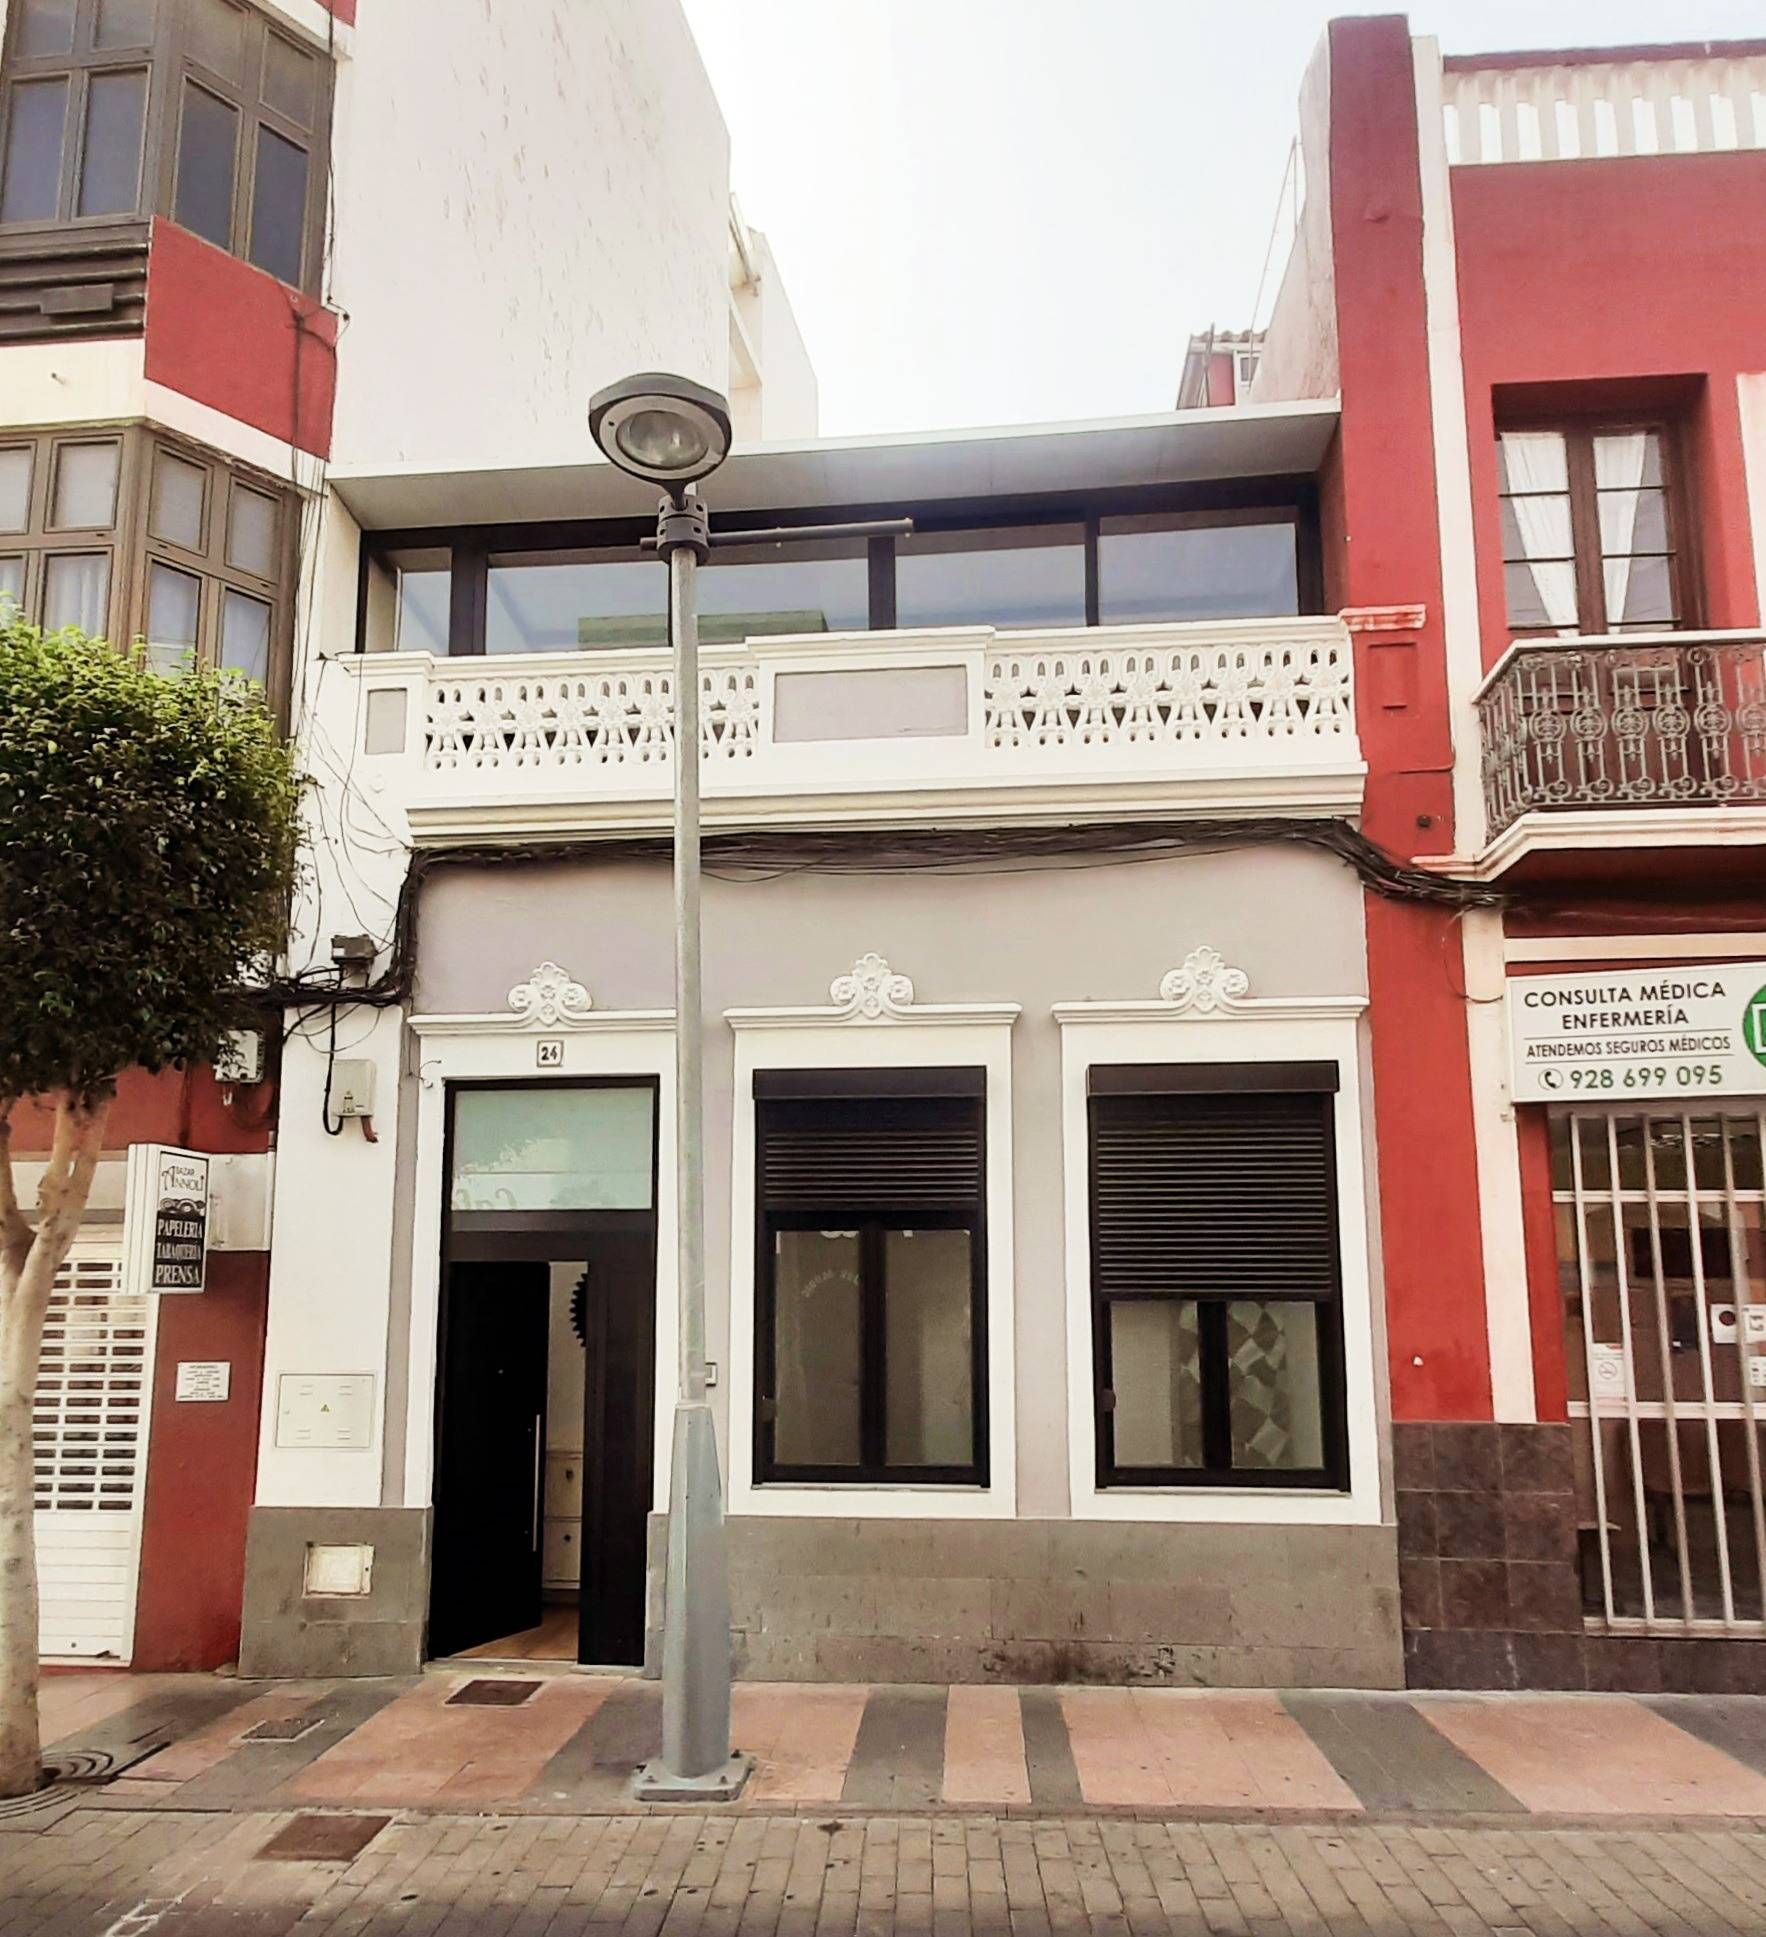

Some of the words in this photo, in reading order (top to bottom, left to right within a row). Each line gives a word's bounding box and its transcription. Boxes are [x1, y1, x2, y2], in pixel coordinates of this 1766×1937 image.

[1524, 986, 1633, 1008] CONSULTA
[1639, 979, 1726, 1001] MÉDICA
[1562, 1004, 1689, 1030] ENFERMERÍA
[541, 1045, 558, 1061] 24
[1526, 1041, 1602, 1058] ATENDEMOS
[1606, 1039, 1665, 1055] SEGUROS
[1669, 1034, 1731, 1052] MÉDICOS
[1570, 1068, 1614, 1089] 928
[1622, 1067, 1667, 1088] 699
[1676, 1064, 1723, 1086] 095
[155, 1263, 200, 1285] PRENSA
